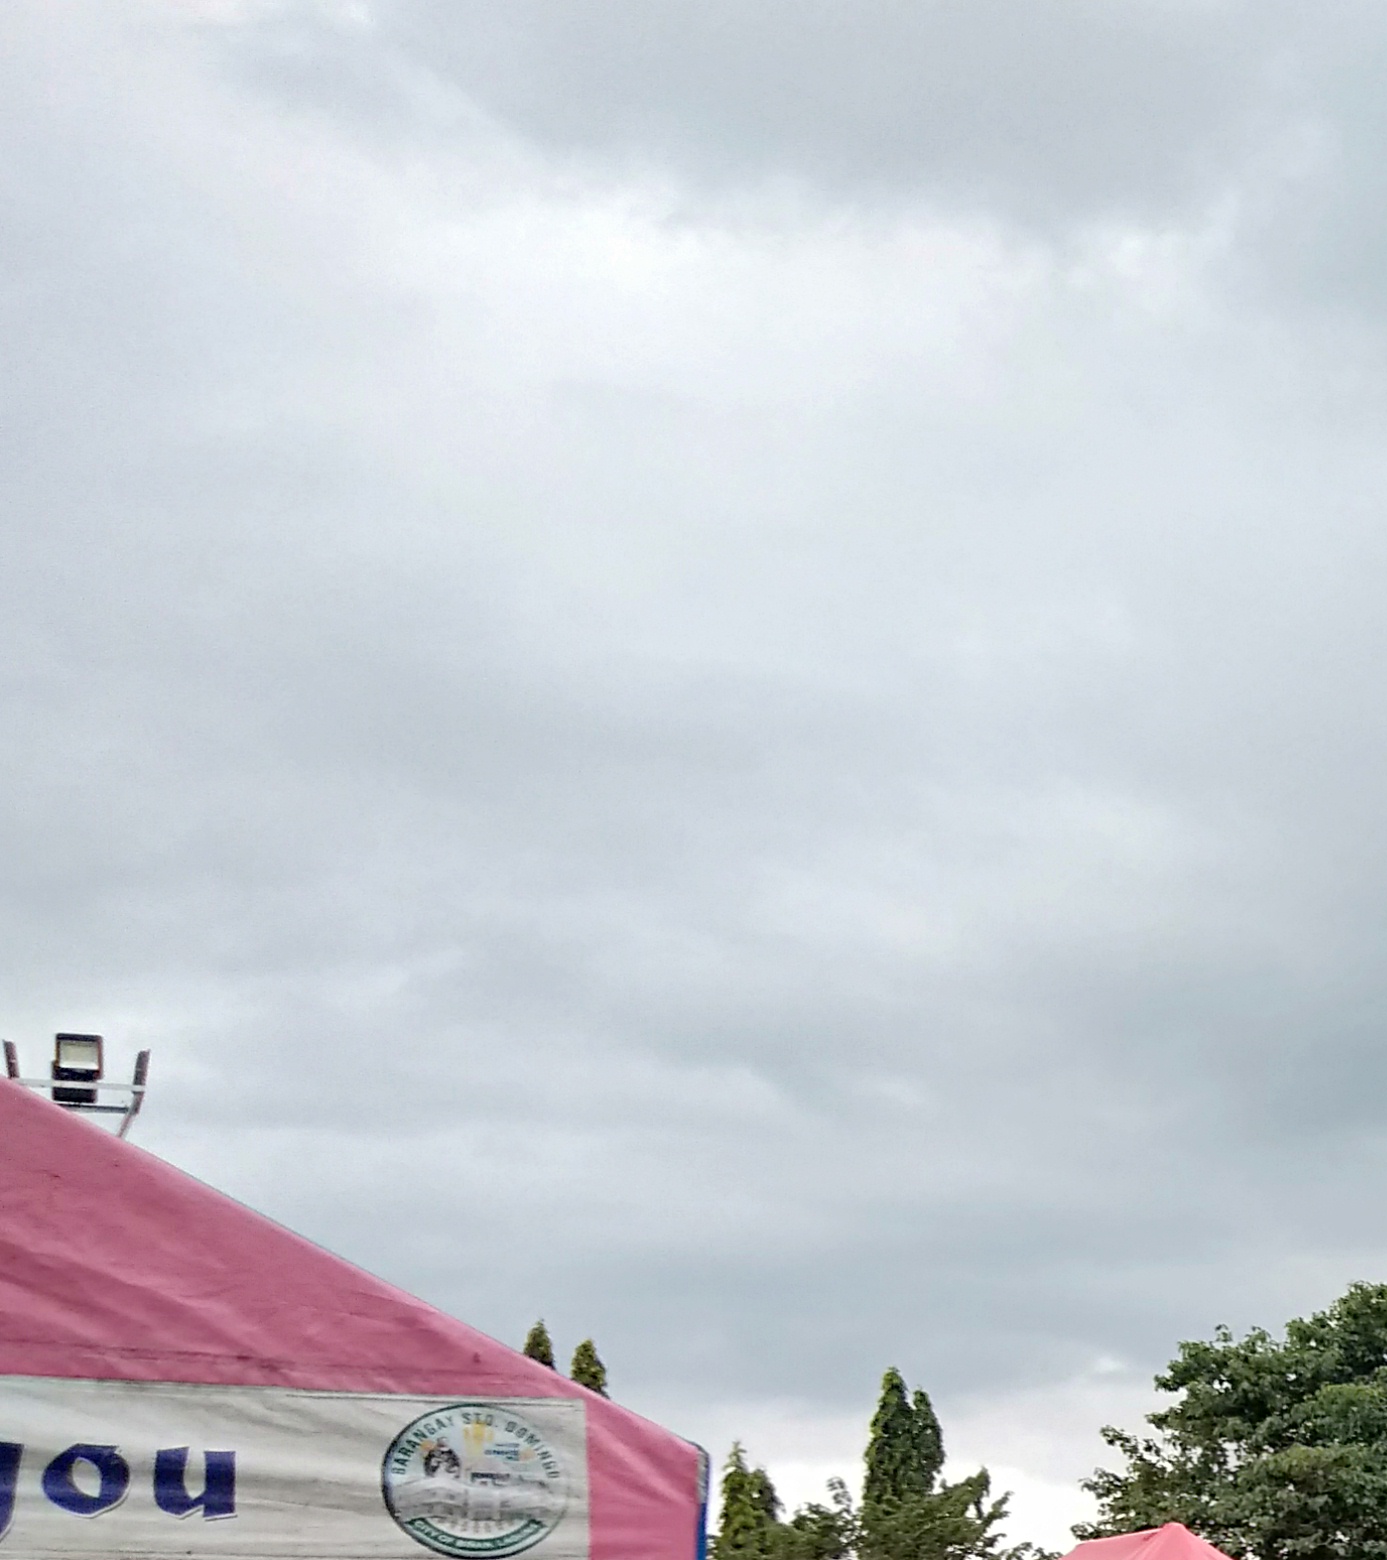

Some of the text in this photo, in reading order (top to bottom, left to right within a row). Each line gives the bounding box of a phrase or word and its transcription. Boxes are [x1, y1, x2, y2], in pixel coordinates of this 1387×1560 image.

[391, 1412, 560, 1479] BARANGAY STO. DOMINGO
[0, 1441, 237, 1541] ou
